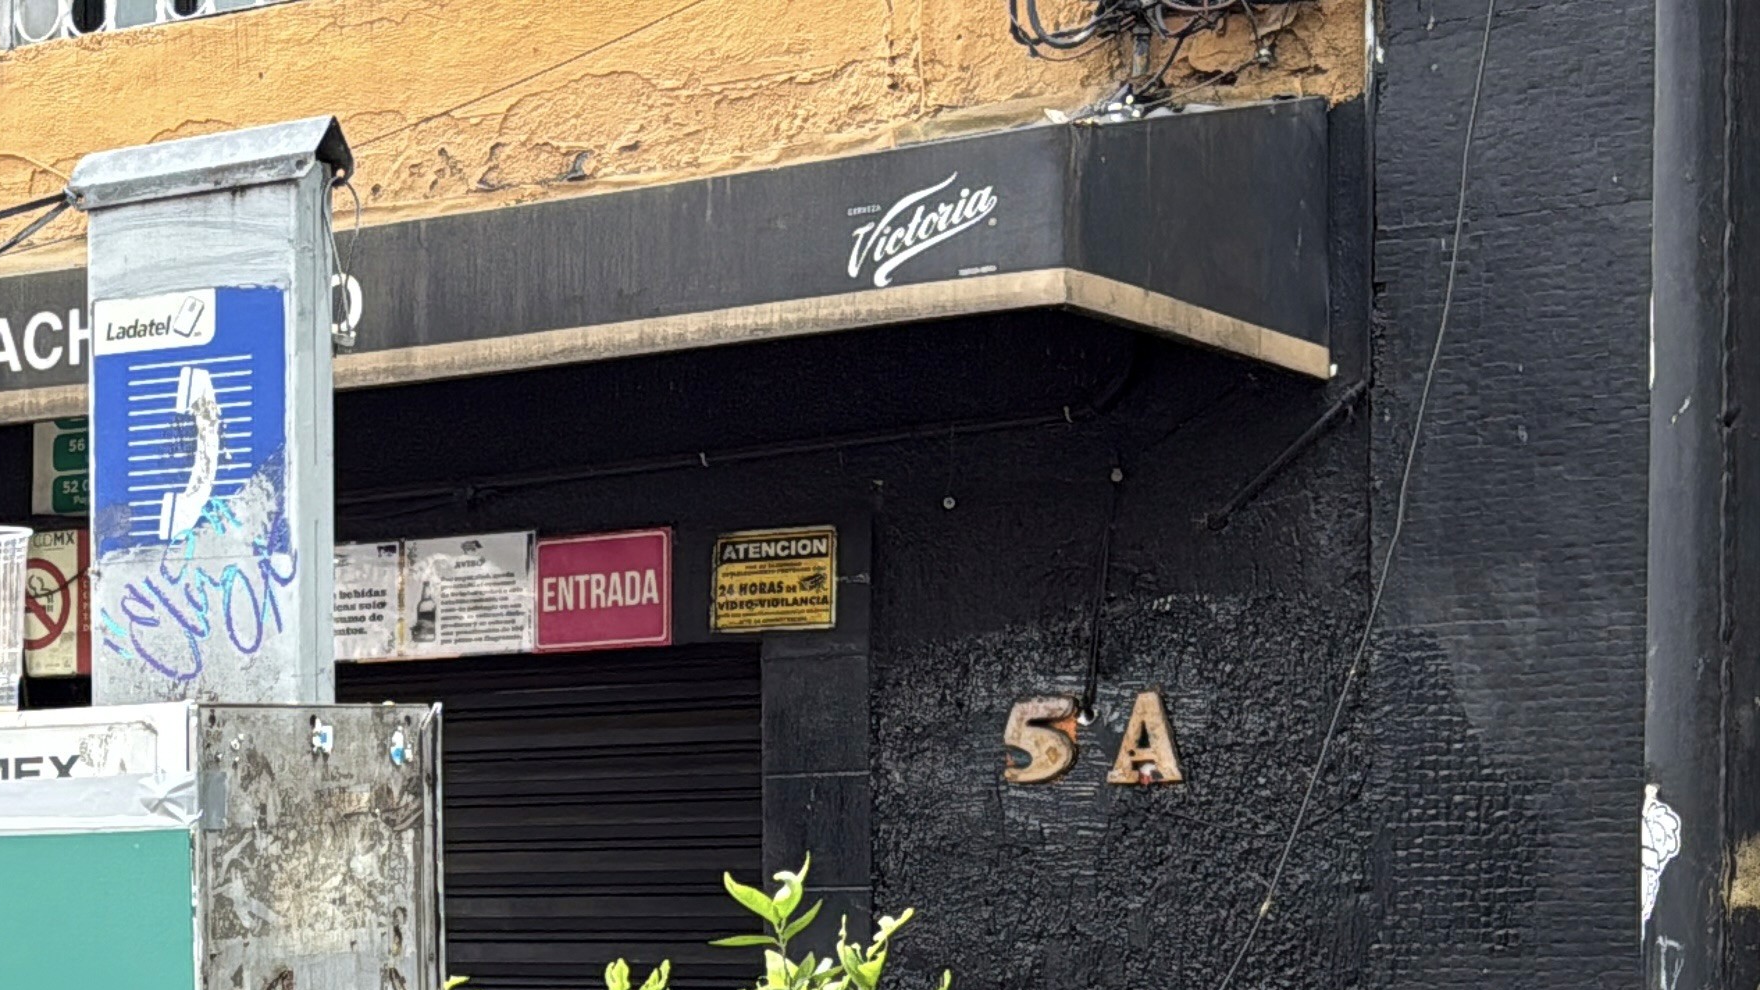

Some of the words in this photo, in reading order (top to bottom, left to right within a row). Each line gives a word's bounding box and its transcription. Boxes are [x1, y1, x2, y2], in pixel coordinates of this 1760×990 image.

[847, 171, 998, 287] Victoria
[106, 314, 172, 341] Ladatel
[722, 538, 828, 561] ATENCION
[542, 568, 660, 613] ENTRADA
[739, 580, 784, 596] HORAS
[1003, 695, 1079, 785] 5
[1106, 690, 1185, 785] A
